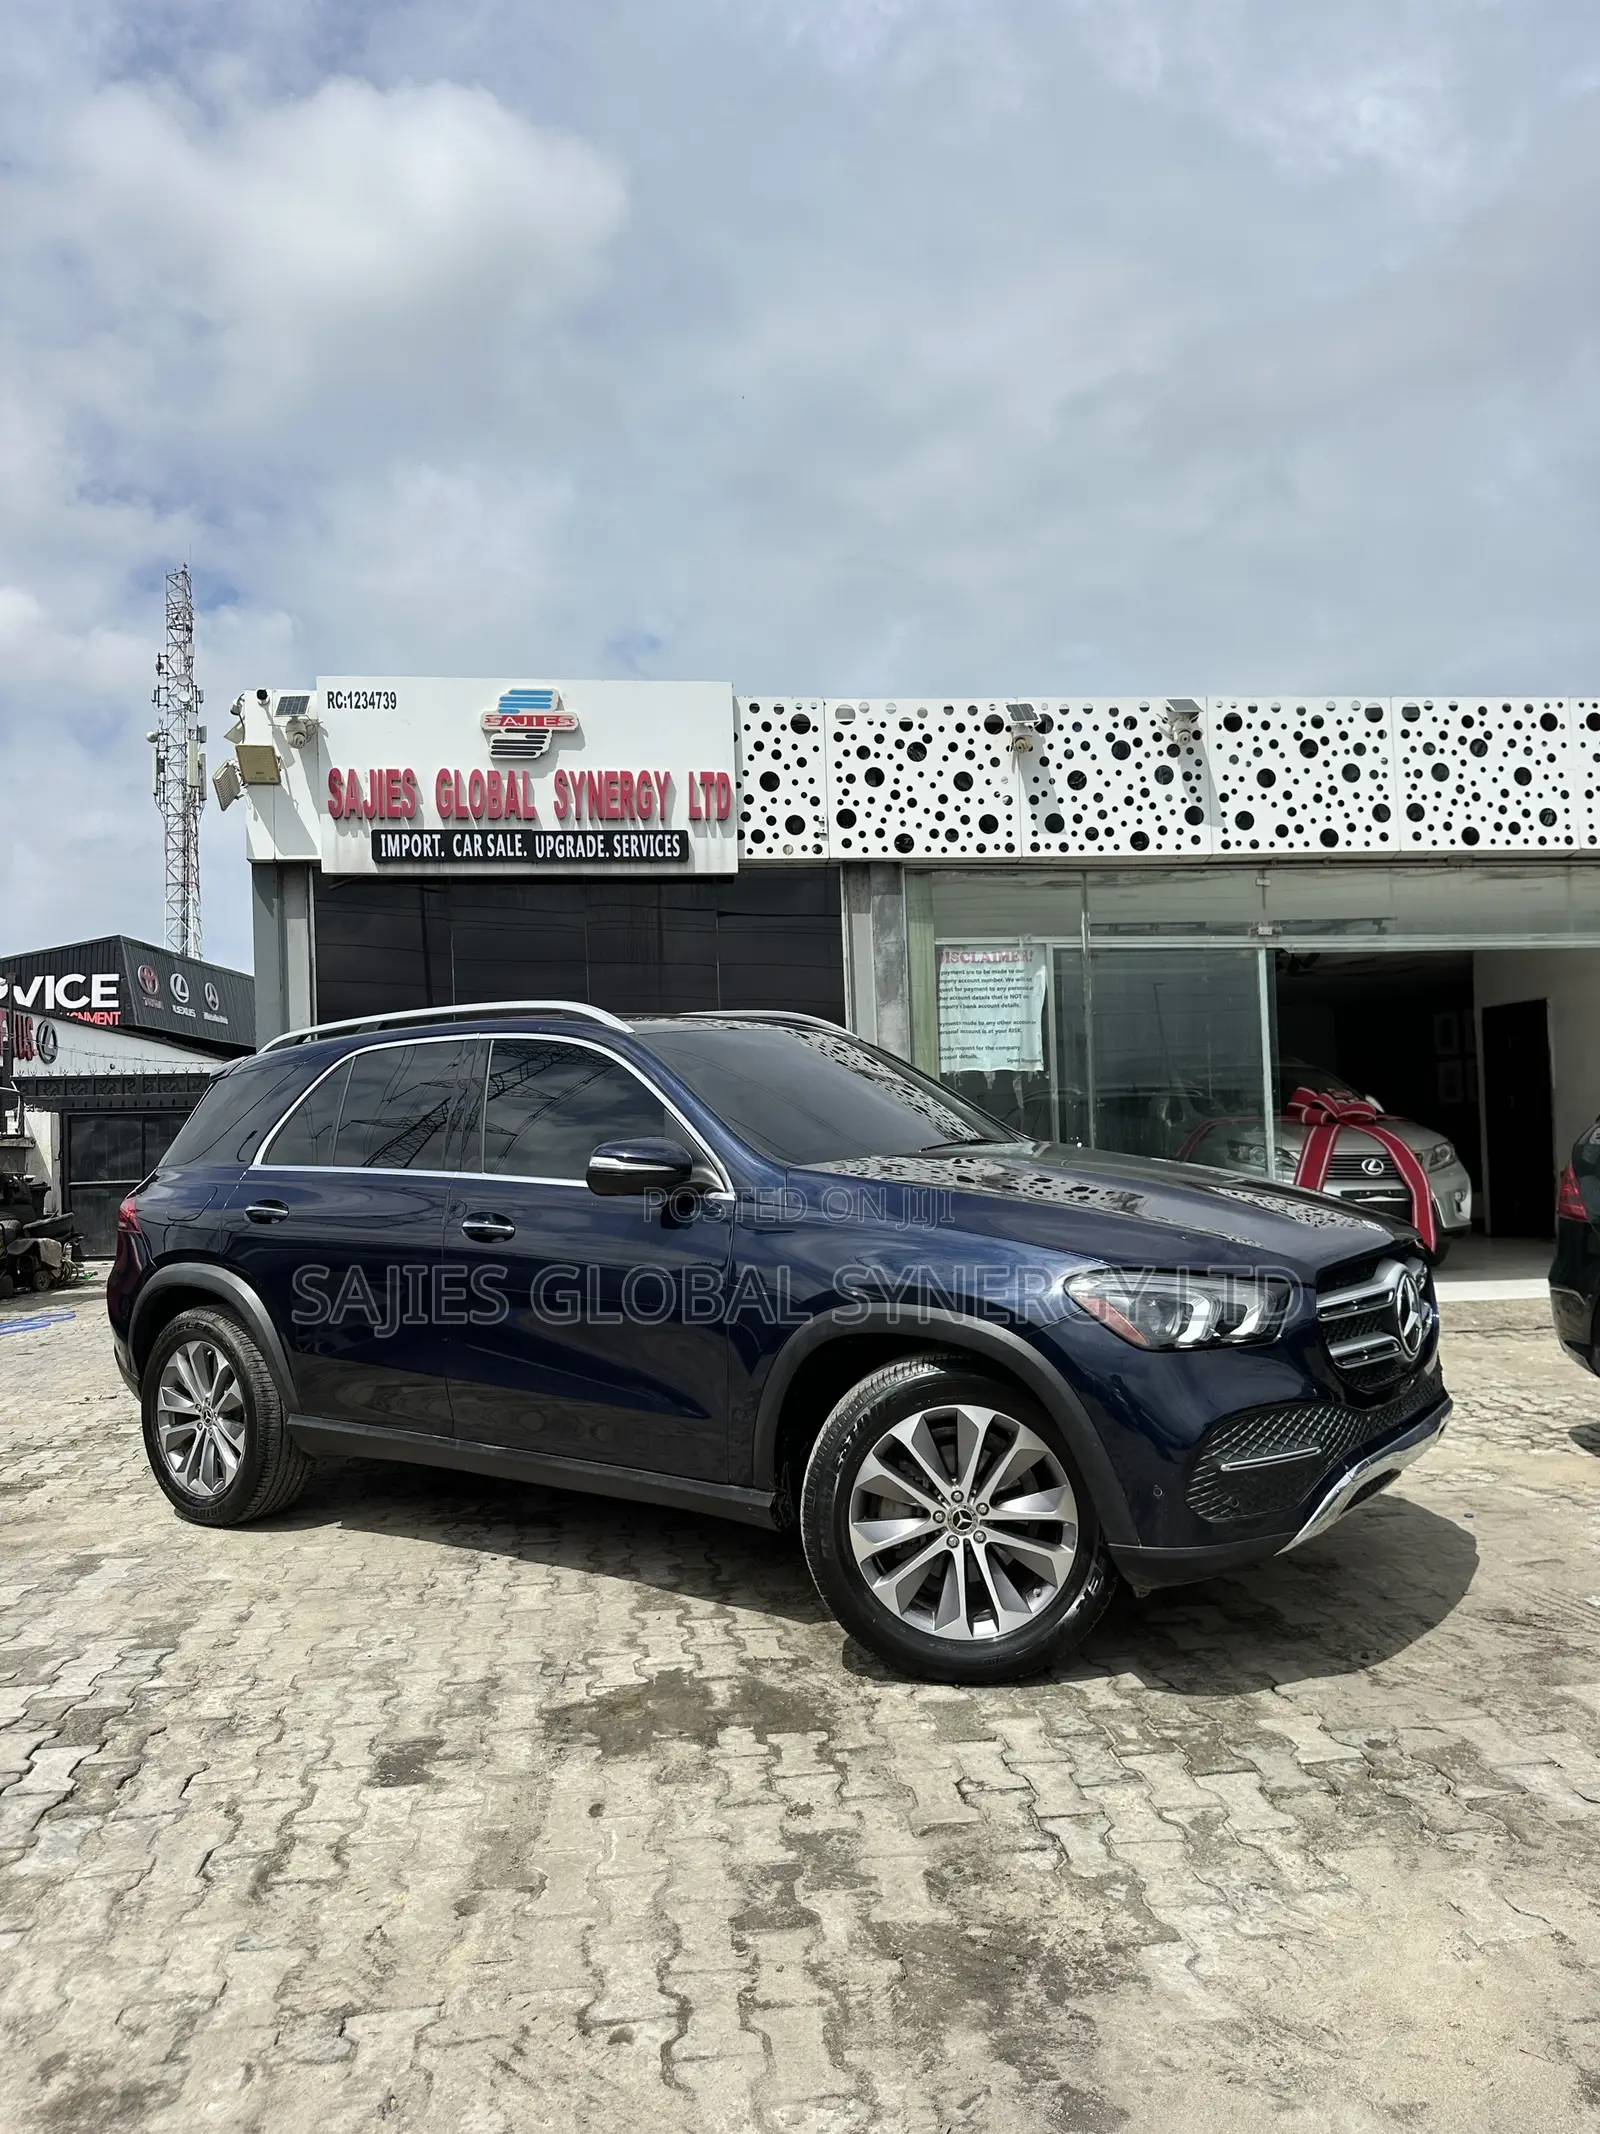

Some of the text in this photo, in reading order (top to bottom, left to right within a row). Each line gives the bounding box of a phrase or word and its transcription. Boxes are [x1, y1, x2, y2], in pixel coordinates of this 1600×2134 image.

[327, 691, 397, 710] RC:1234739
[486, 714, 576, 727] SAJIES
[327, 767, 732, 821] SAJIES GLOBAL SYNERGY LTD
[380, 833, 680, 858] IMPORT. CAR SALE. UPGRADE. SERVICES
